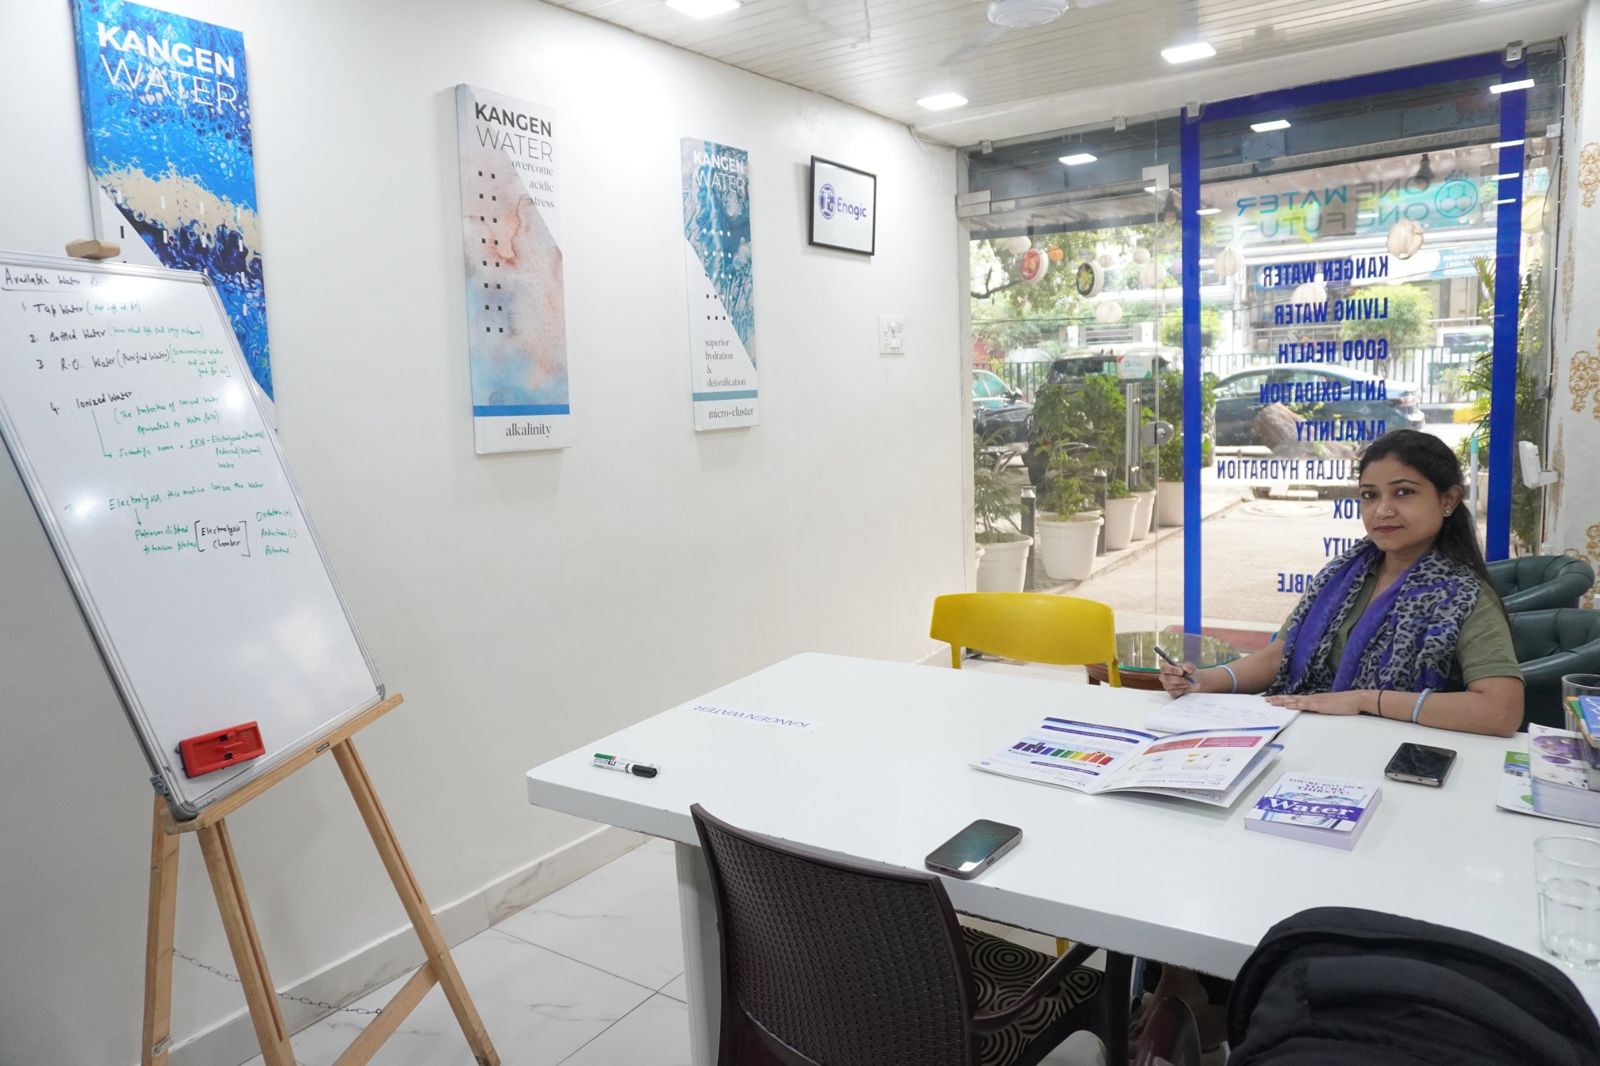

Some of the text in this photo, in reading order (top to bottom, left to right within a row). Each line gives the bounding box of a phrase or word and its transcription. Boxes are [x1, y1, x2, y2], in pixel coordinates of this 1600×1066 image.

[97, 21, 236, 79] KANGEN
[100, 53, 237, 112] WATER
[475, 102, 552, 138] KANGEN
[475, 124, 553, 163] WATER
[511, 160, 554, 176] overcome
[693, 149, 744, 174] KANGEN
[529, 180, 554, 193] acidic
[692, 170, 746, 195] WATER
[528, 196, 556, 209] stress
[837, 196, 867, 220] Enagic
[5, 266, 49, 286] Available
[33, 303, 57, 318] Tap
[59, 303, 84, 316] Water
[82, 328, 106, 340] Water
[704, 338, 730, 349] superior
[91, 355, 116, 368] Water
[705, 350, 734, 363] hydration
[706, 378, 747, 388] detoxification
[76, 393, 107, 409] Ionized
[108, 390, 133, 402] Water
[708, 405, 754, 419] micro-cluster
[505, 422, 551, 439] alkalinity
[1269, 798, 1354, 817] Water
